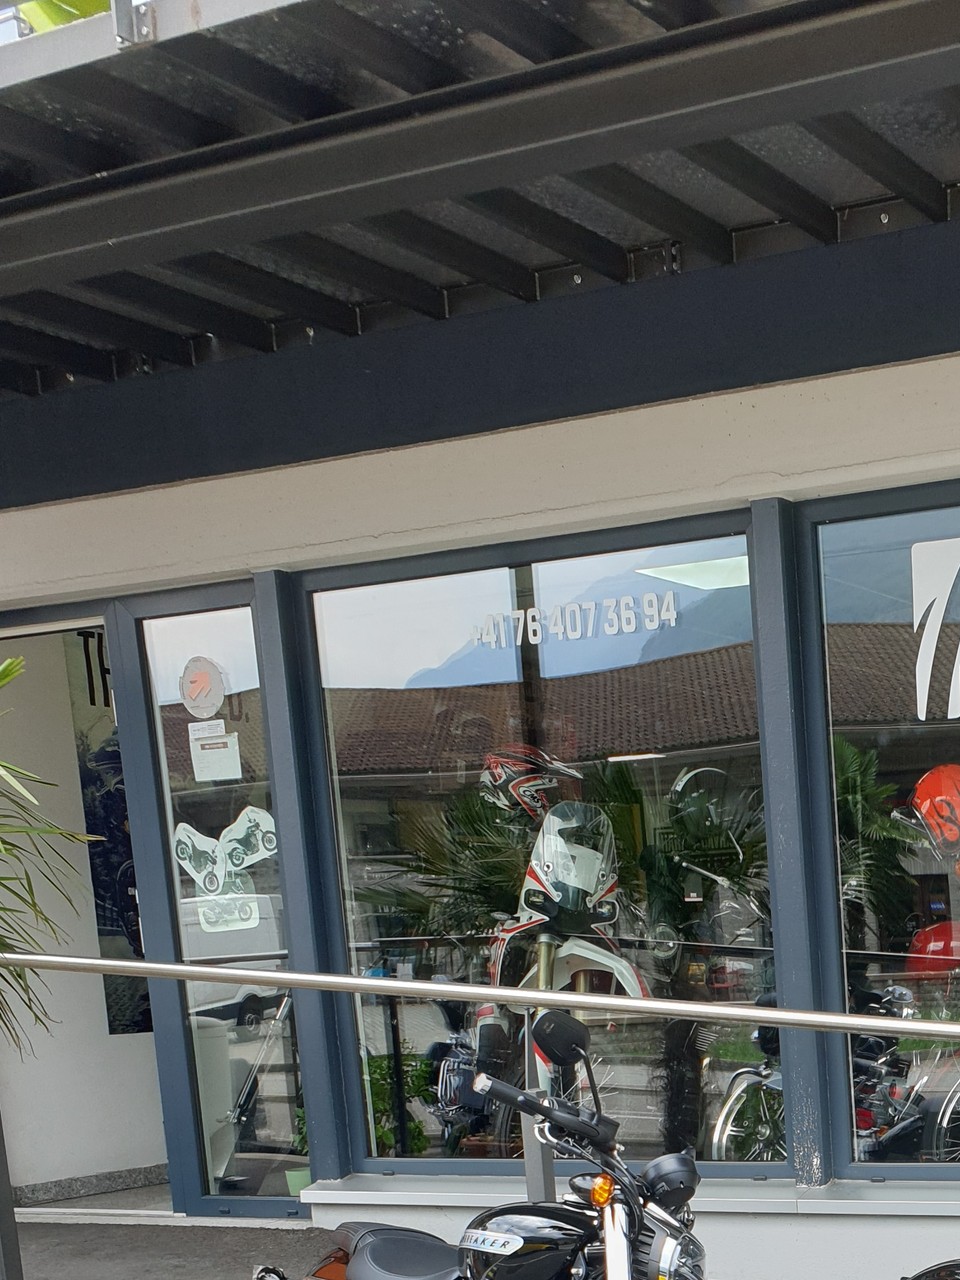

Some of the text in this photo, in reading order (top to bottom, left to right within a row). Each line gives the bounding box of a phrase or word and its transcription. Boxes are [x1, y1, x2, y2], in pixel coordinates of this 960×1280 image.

[470, 590, 678, 649] +41 76 407 36 94
[522, 788, 541, 805] CMS
